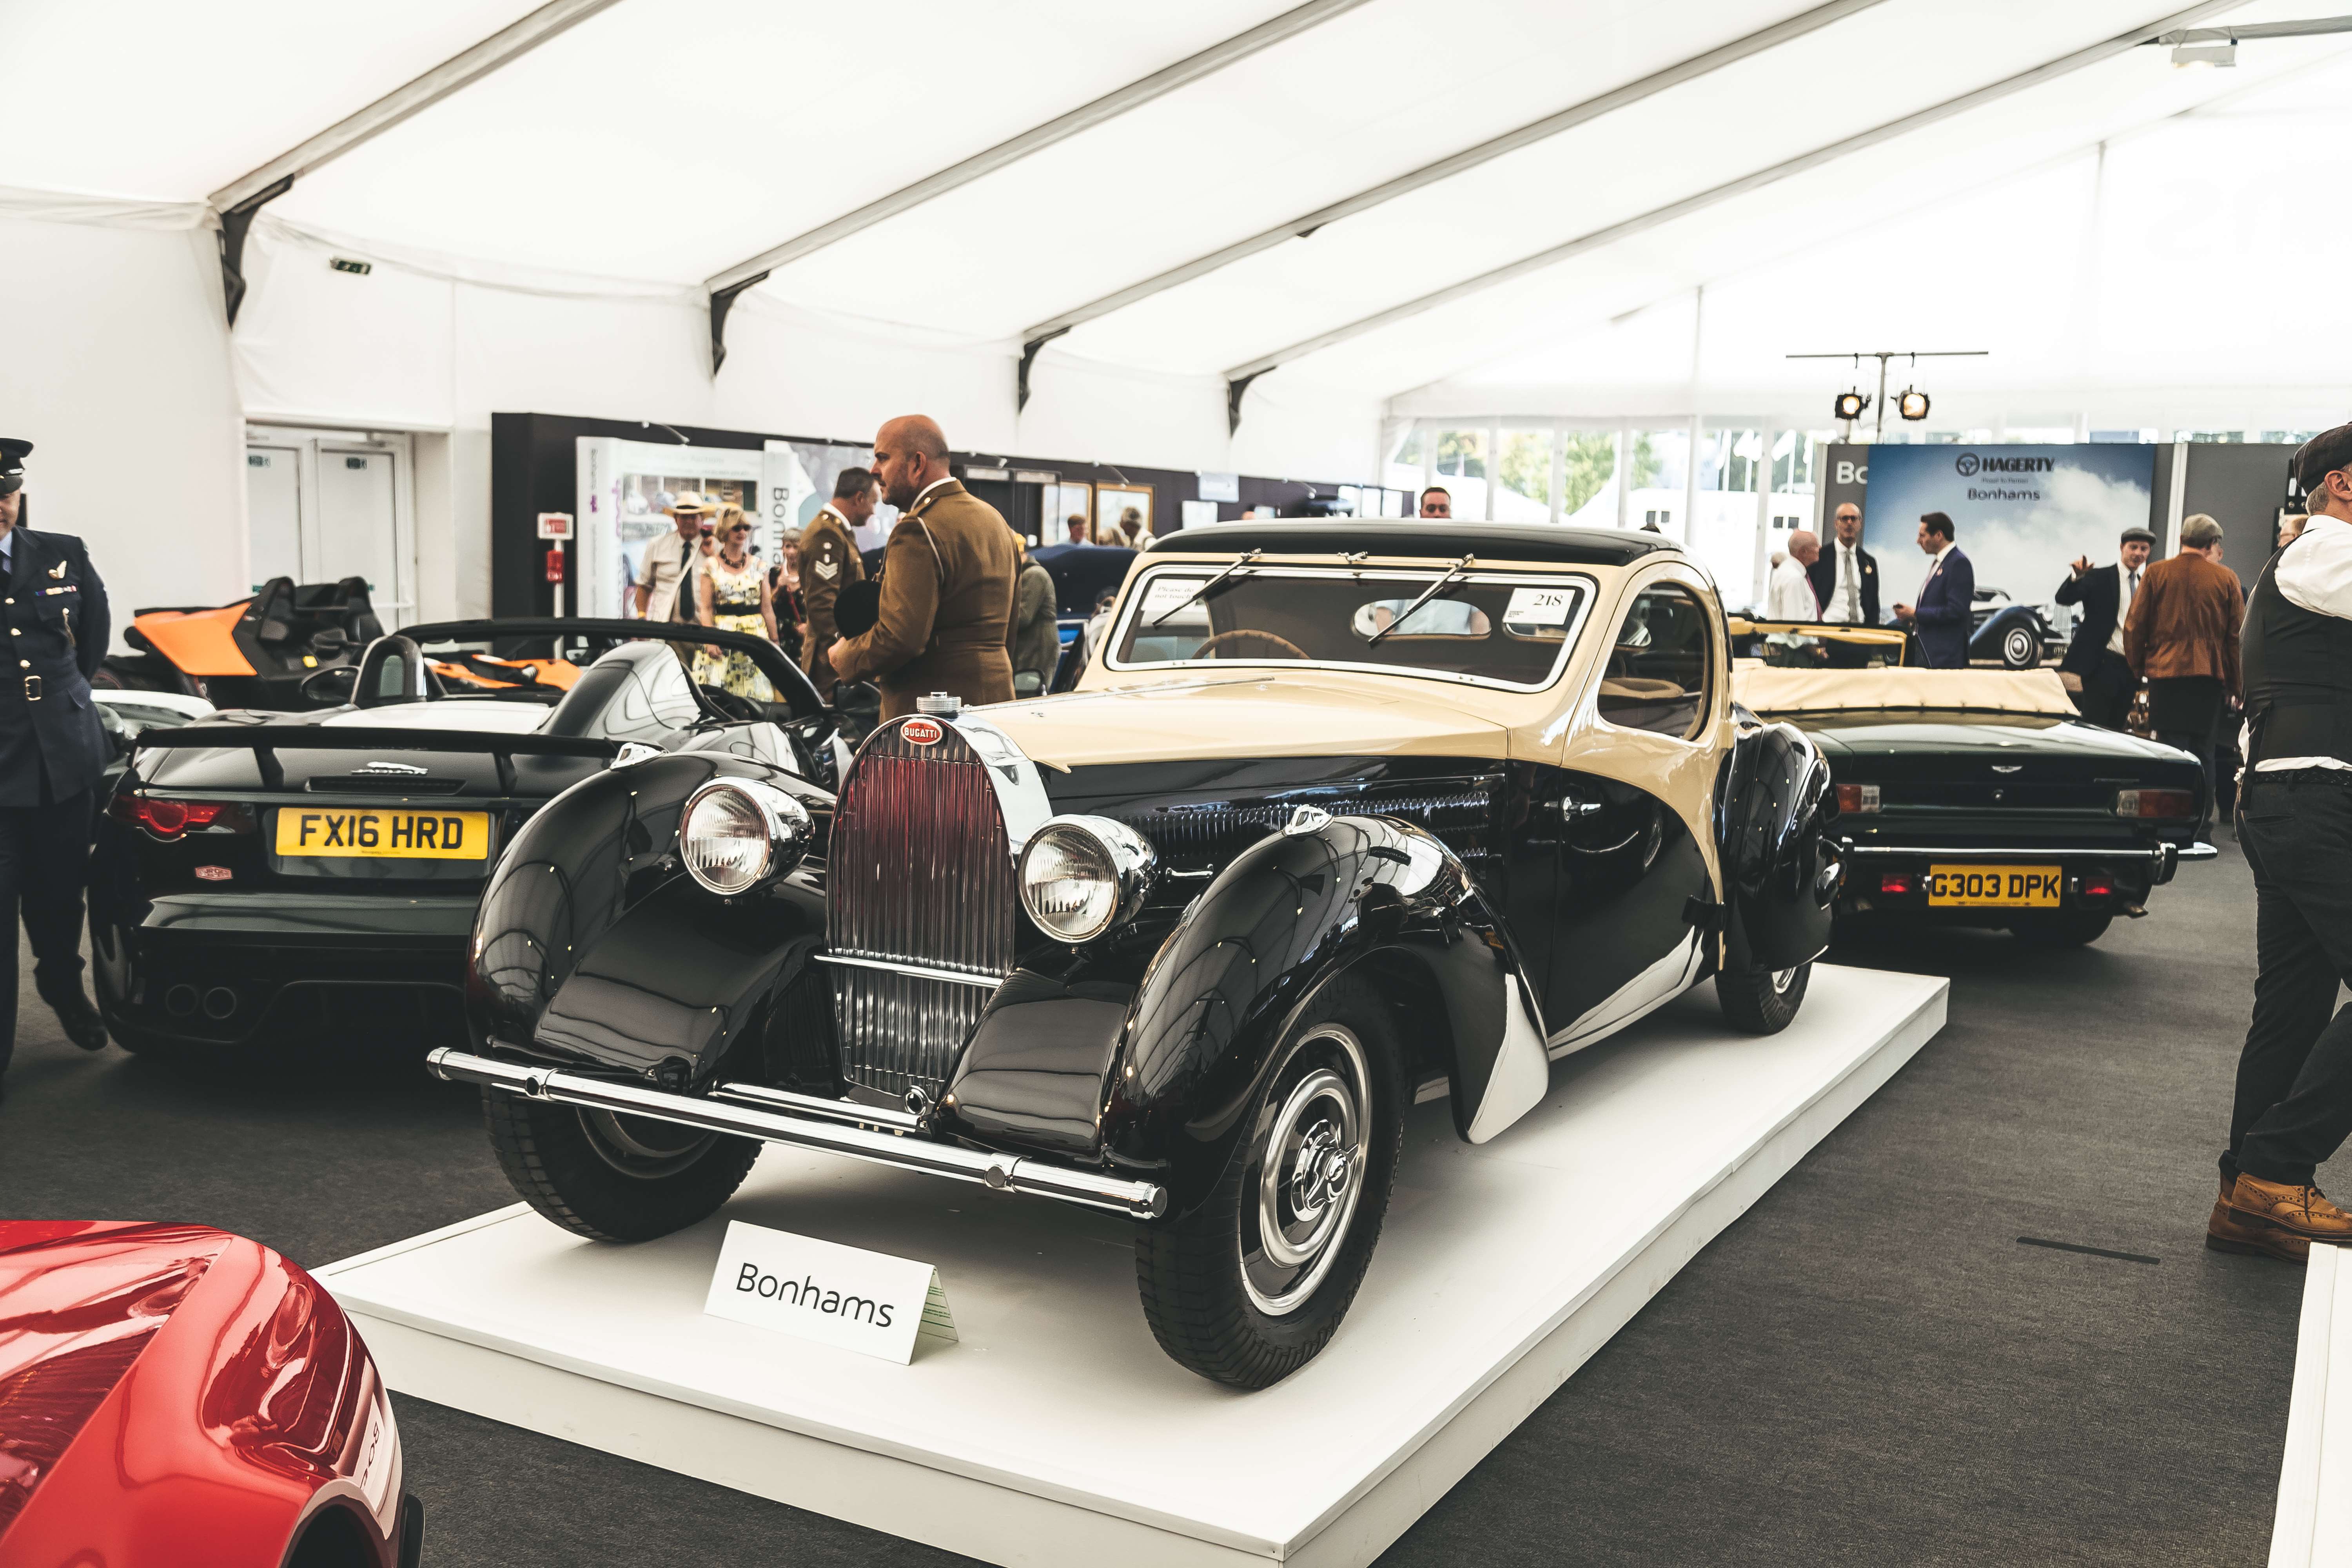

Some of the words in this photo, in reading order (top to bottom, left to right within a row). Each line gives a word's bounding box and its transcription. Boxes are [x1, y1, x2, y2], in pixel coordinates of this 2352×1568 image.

[1982, 457, 2055, 472] HAGERTY
[1967, 488, 2040, 501] Bonhams
[1533, 594, 1563, 606] 218
[904, 727, 937, 739] BUGATTI
[299, 814, 379, 847] FX16
[392, 816, 463, 849] HRD
[1931, 873, 2001, 898] G303
[2008, 875, 2060, 898] DPK
[736, 1262, 895, 1328] Bonhams
